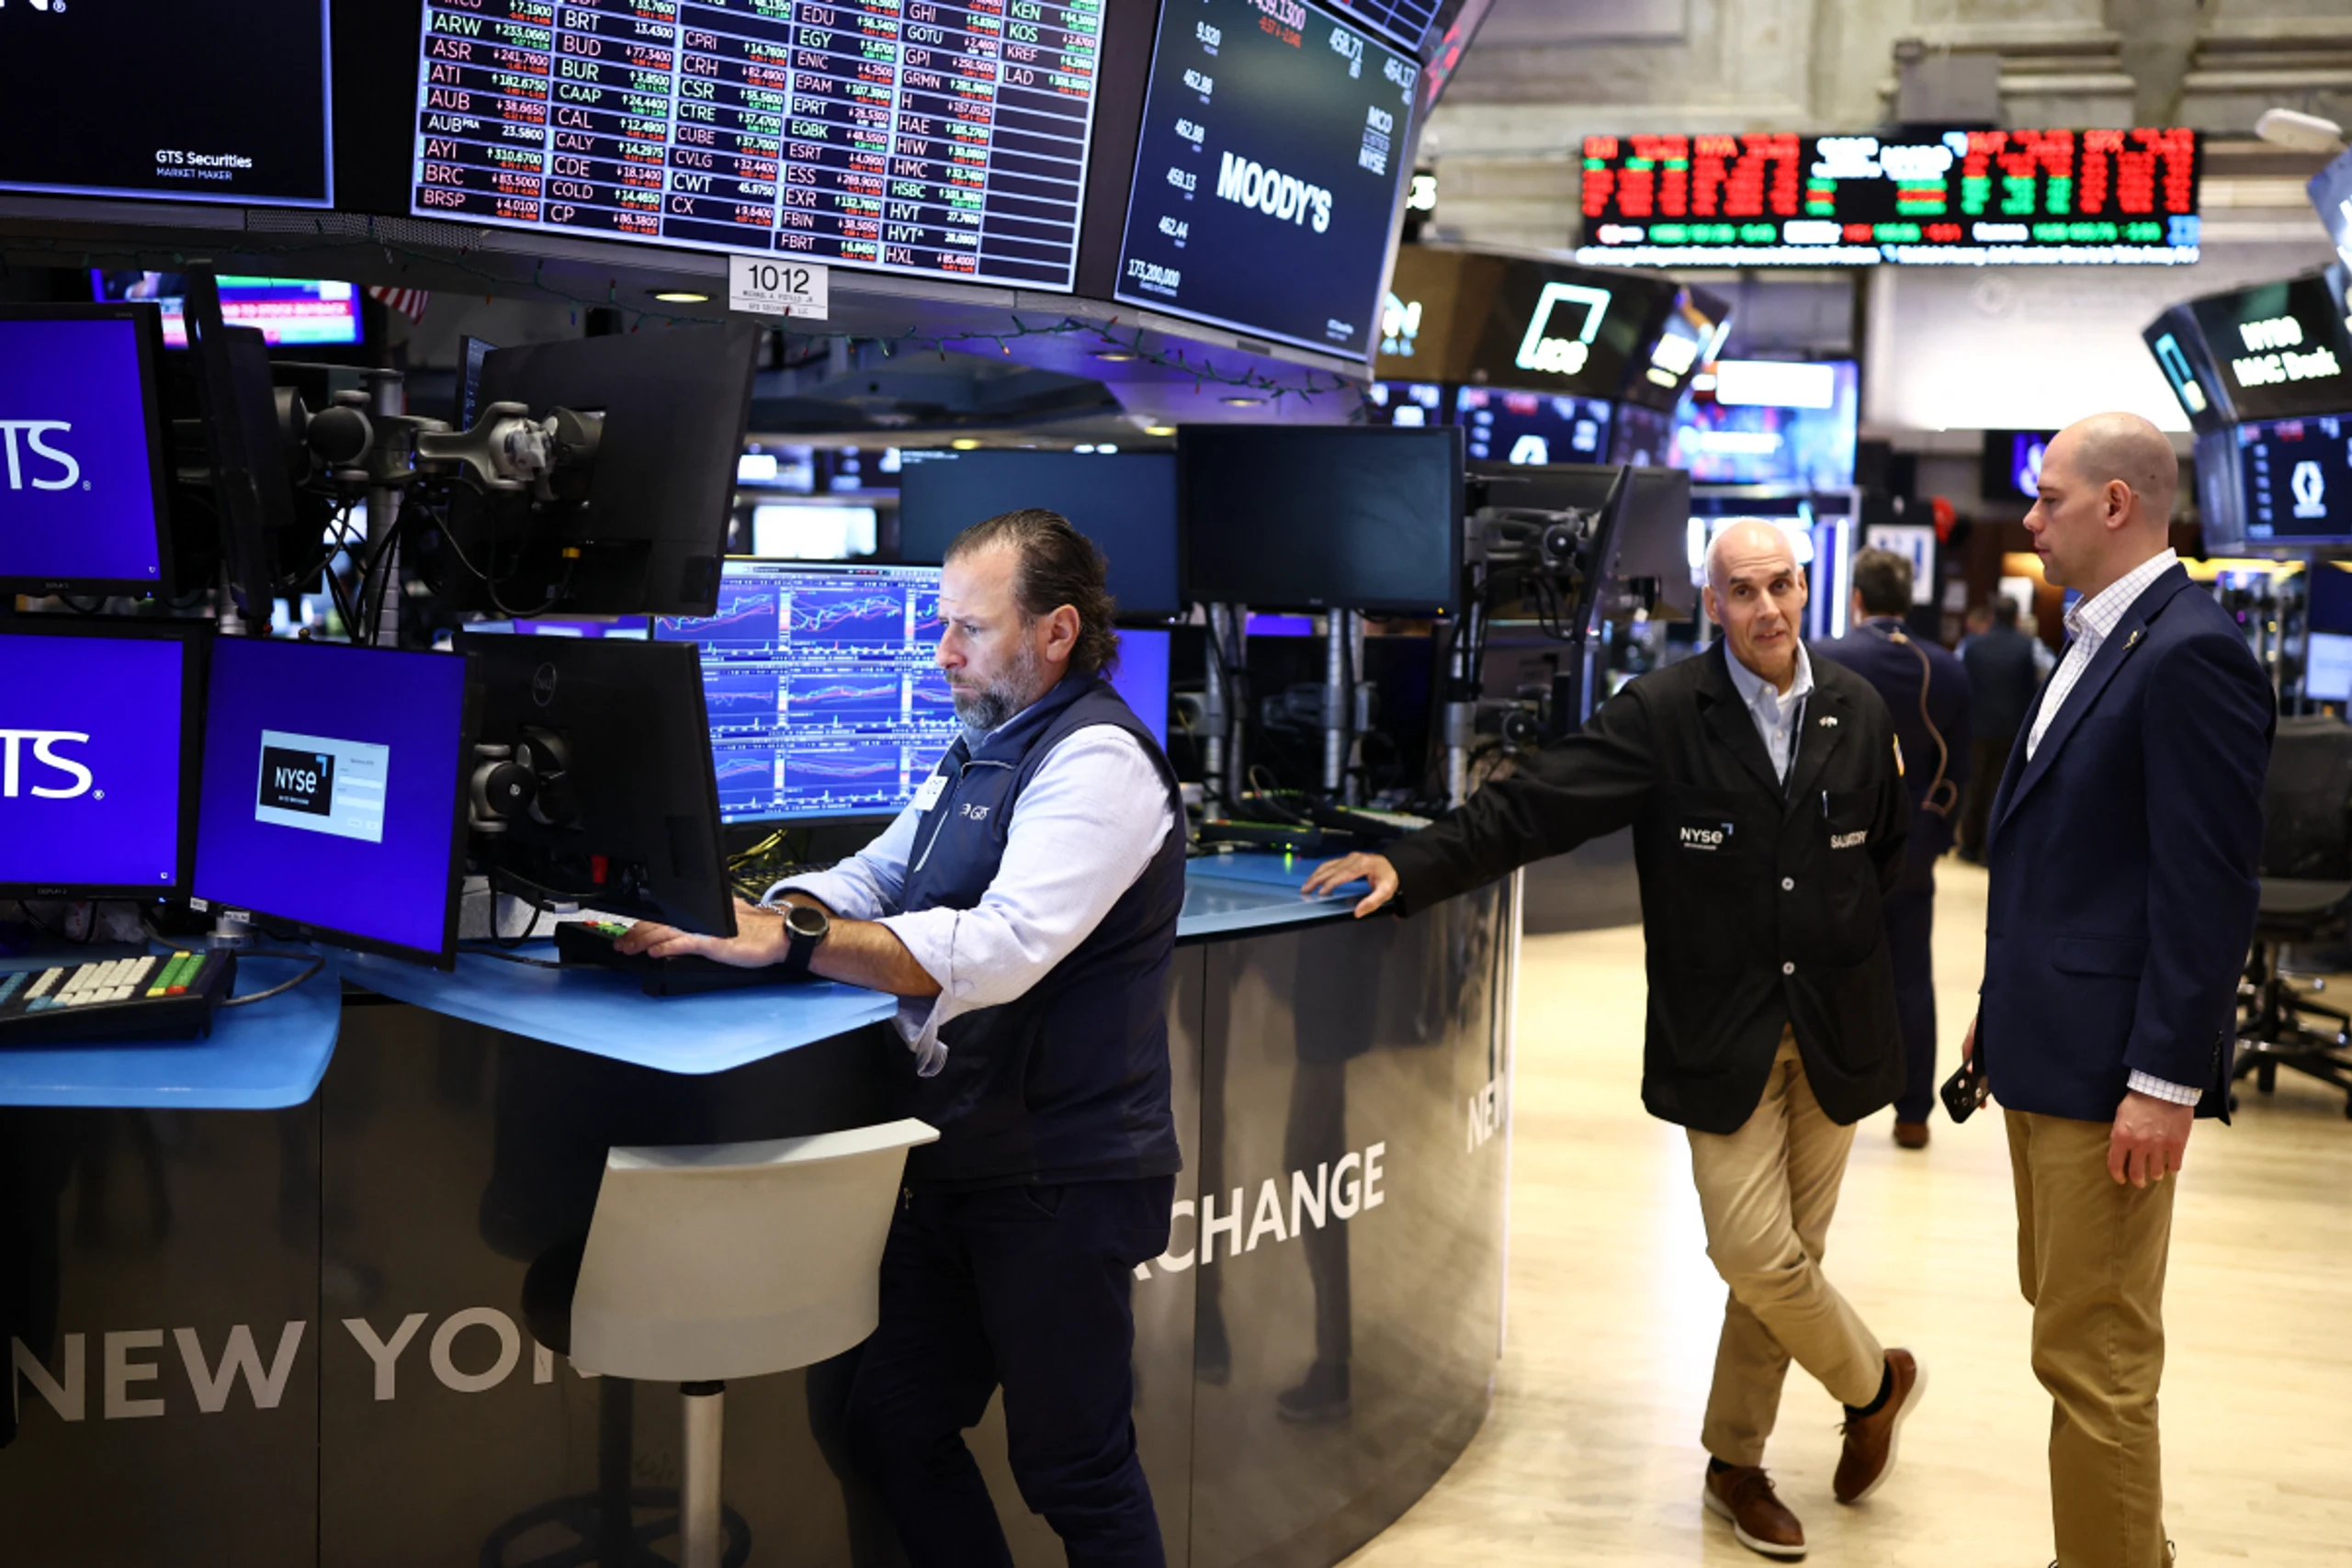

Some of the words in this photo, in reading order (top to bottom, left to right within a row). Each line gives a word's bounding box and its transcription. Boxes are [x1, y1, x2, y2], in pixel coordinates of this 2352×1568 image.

[563, 9, 601, 32] BRT
[801, 6, 835, 27] EDU
[909, 4, 936, 23] GHI
[1011, 2, 1042, 21] KEN
[434, 13, 481, 36] ARW
[1009, 23, 1039, 42] KOS
[684, 31, 718, 51] CPRI
[799, 28, 832, 49] EGY
[908, 26, 944, 45] GOTU
[433, 39, 471, 61] ASR
[562, 34, 602, 57] BUD
[1006, 45, 1038, 62] KREF
[683, 55, 719, 77] CRH
[797, 51, 829, 70] ENIC
[905, 49, 931, 67] GPI
[431, 64, 460, 85] ATI
[560, 59, 599, 82] BUR
[903, 71, 941, 89] GRMN
[1005, 66, 1035, 85] LAD
[559, 84, 602, 103] CAAP
[681, 80, 715, 100] CSR
[795, 74, 832, 94] EPAM
[429, 89, 470, 110] AUB
[793, 97, 828, 116] EPRT
[900, 94, 912, 109] H
[558, 107, 594, 130] CAL
[679, 103, 717, 122] CTRE
[791, 121, 829, 139] EQBK
[899, 116, 931, 135] HAE
[556, 132, 595, 151] CALY
[677, 127, 716, 146] CUBE
[426, 139, 457, 159] AYI
[789, 143, 823, 161] ESRT
[896, 137, 929, 156] HIW
[155, 150, 183, 164] GTS
[187, 152, 252, 168] Securities
[554, 156, 592, 177] CDE
[675, 151, 713, 168] CVLG
[894, 159, 928, 178] HMC
[424, 164, 464, 185] BRC
[673, 173, 713, 194] CWT
[787, 166, 817, 185] ESS
[423, 188, 466, 207] BRSP
[552, 181, 594, 199] COLD
[785, 187, 817, 208] EXR
[891, 180, 927, 199] HSBC
[1216, 151, 1333, 233] MOODY'S
[550, 205, 575, 222] CP
[672, 196, 695, 215] CX
[889, 203, 922, 221] HVT
[783, 210, 815, 229] FBIN
[780, 233, 815, 251] FBRT
[886, 246, 915, 265] HXL
[748, 264, 809, 295] 1012
[1133, 1141, 1385, 1281] CHANGE
[342, 1306, 603, 1403] YO
[11, 1320, 307, 1423] NEW
